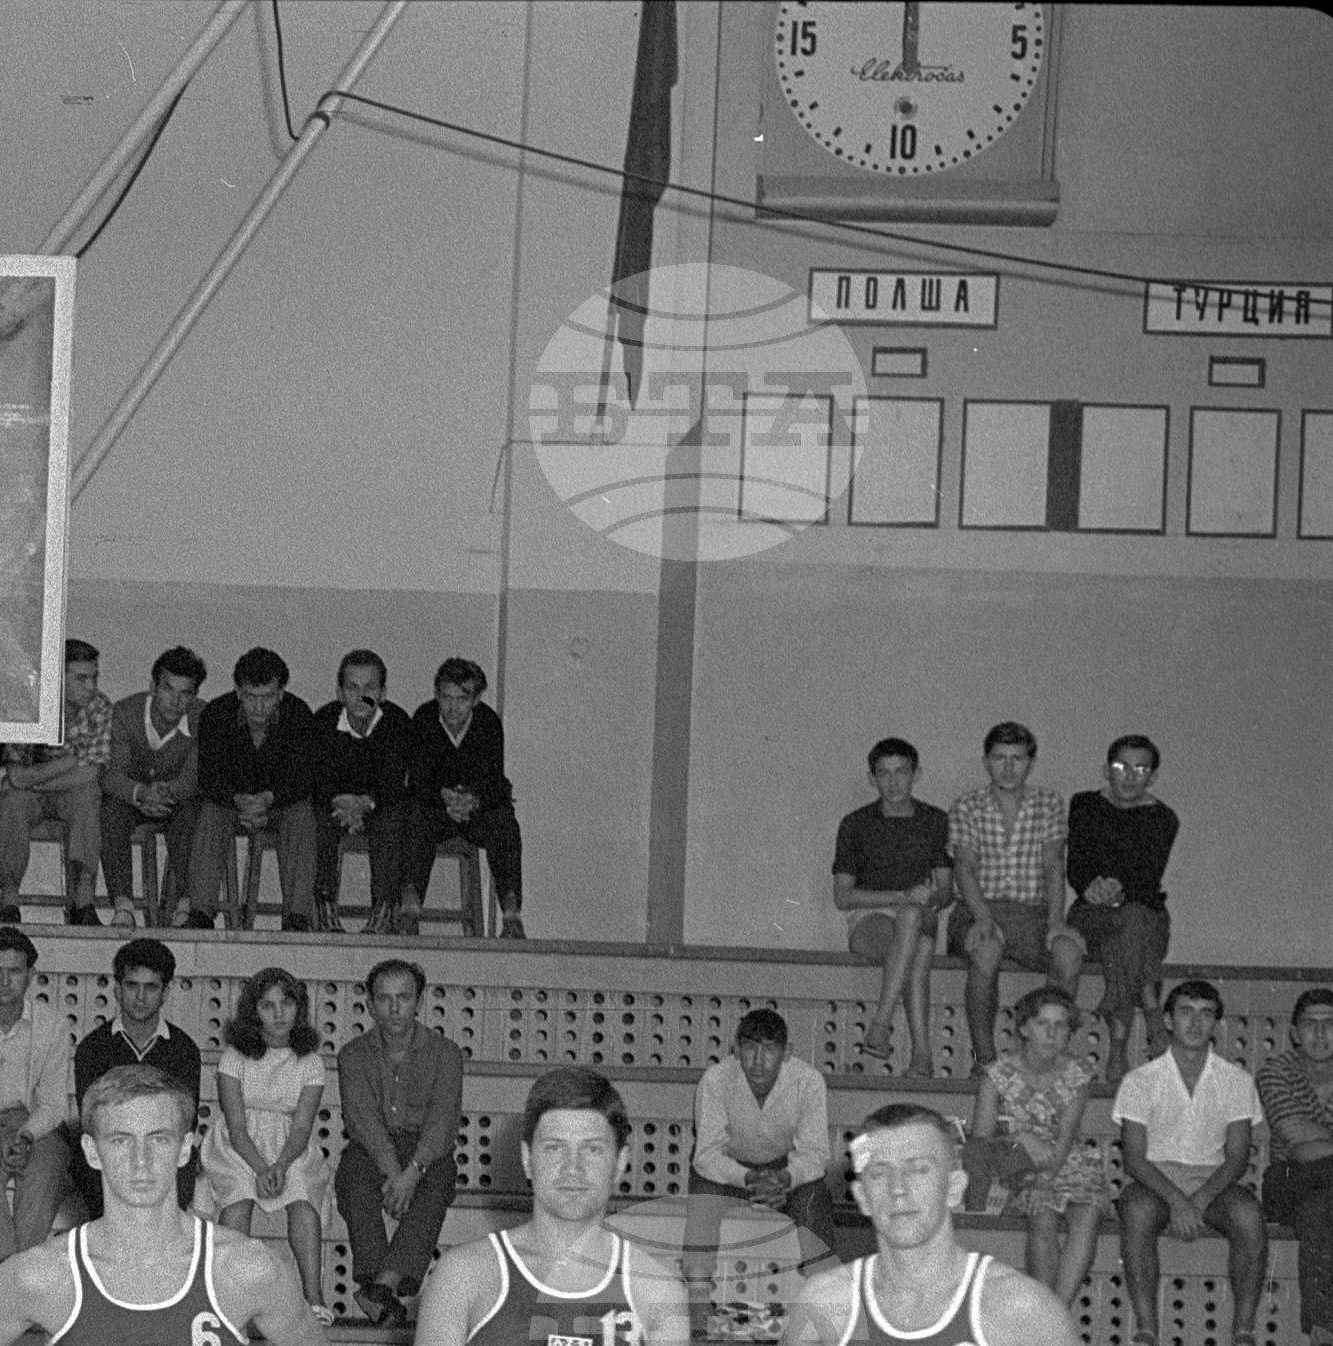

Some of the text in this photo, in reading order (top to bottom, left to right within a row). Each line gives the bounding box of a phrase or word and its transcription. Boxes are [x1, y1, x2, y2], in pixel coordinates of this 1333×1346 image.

[790, 20, 817, 56] 15
[1010, 24, 1028, 60] 5
[889, 124, 918, 160] 10
[836, 275, 969, 312] ПОЛША
[1173, 286, 1311, 326] ТУРЦИЯ
